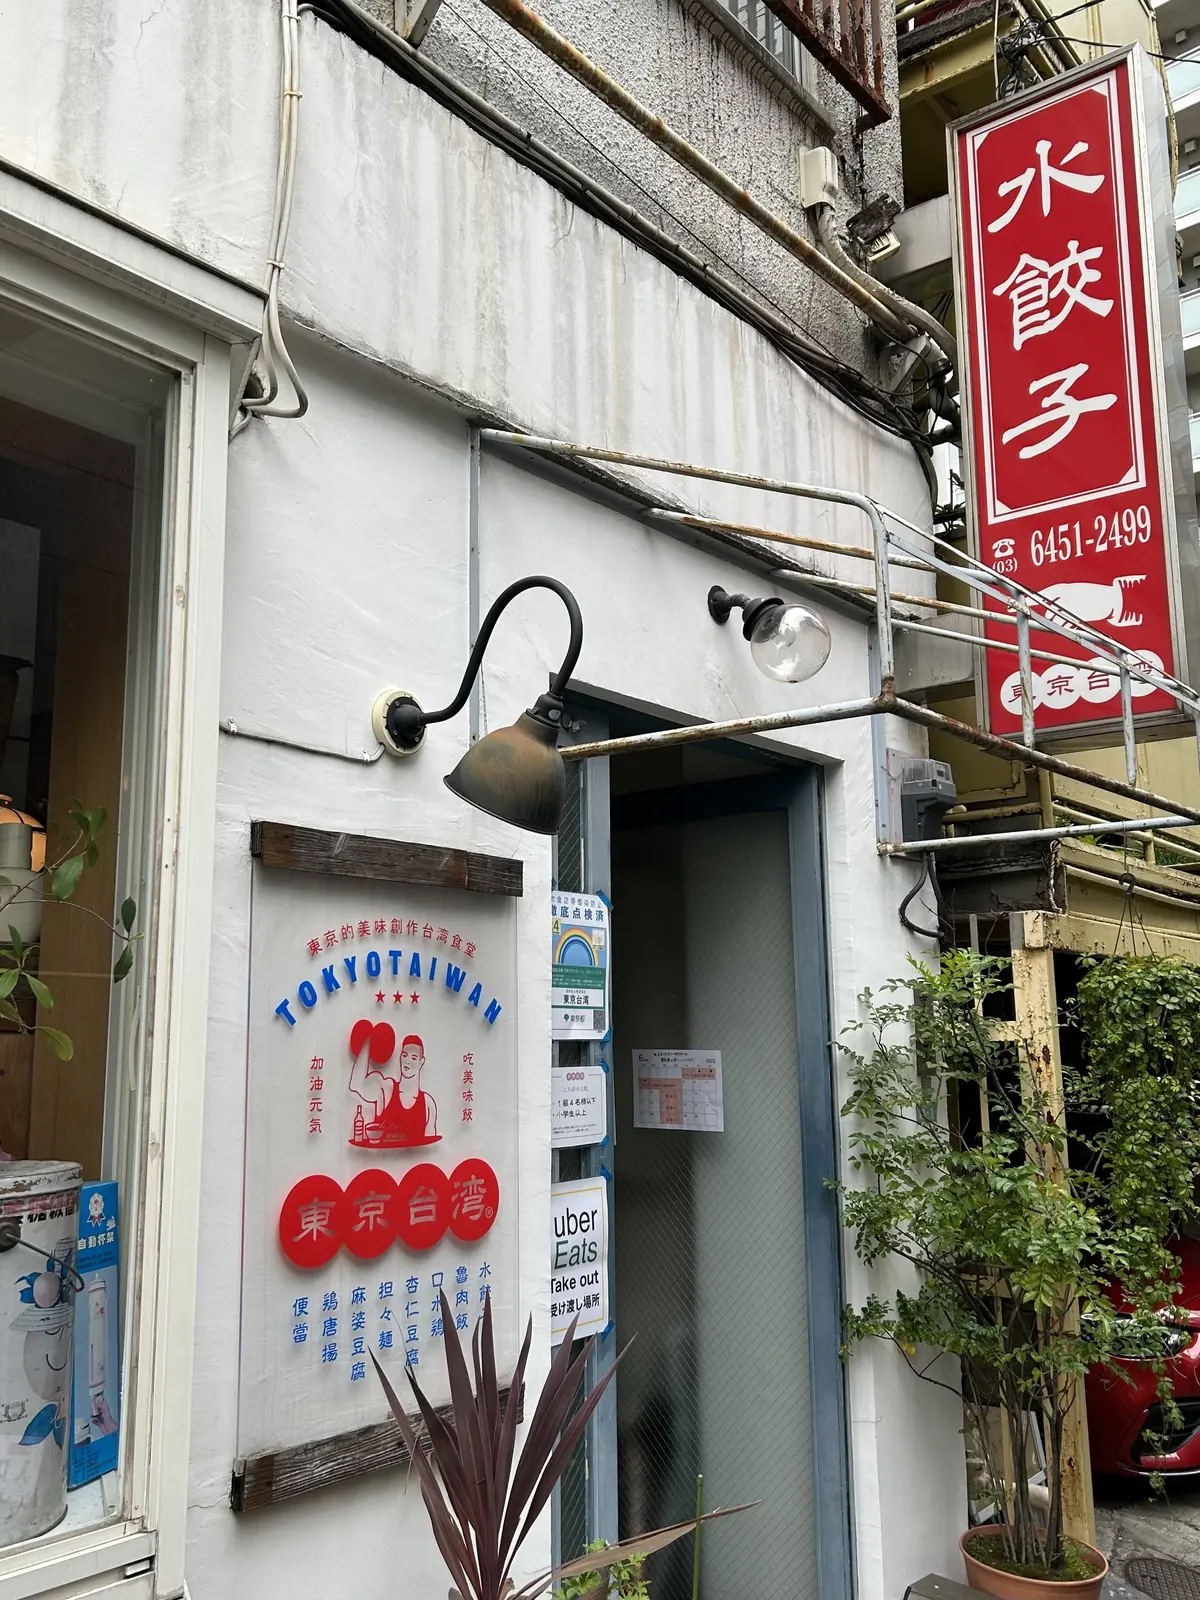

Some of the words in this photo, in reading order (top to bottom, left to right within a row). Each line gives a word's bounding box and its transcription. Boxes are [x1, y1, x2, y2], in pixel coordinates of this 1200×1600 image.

[987, 139, 1118, 460] 水餃子
[992, 557, 1018, 574] (03)
[1030, 504, 1152, 567] 6451-2499
[307, 918, 477, 959] 東京的美味創作台湾食堂
[275, 949, 503, 1027] TOKYOTAIWAN
[563, 994, 590, 1006] 東京台湾
[309, 1055, 324, 1134] 加油元気
[462, 1052, 474, 1122] 吃美味飯
[292, 1174, 487, 1242] 東京台湾
[554, 1207, 598, 1238] uber
[554, 1238, 598, 1270] Eats
[579, 1270, 599, 1287] out
[292, 1296, 309, 1344] 便當
[322, 1290, 339, 1363] 鶏唐揚
[405, 1276, 419, 1368] 杏仁豆腐
[455, 1266, 469, 1331] 魯肉飯
[551, 1293, 601, 1319] 受け渡し場所
[351, 1286, 367, 1381] 麻婆豆腐
